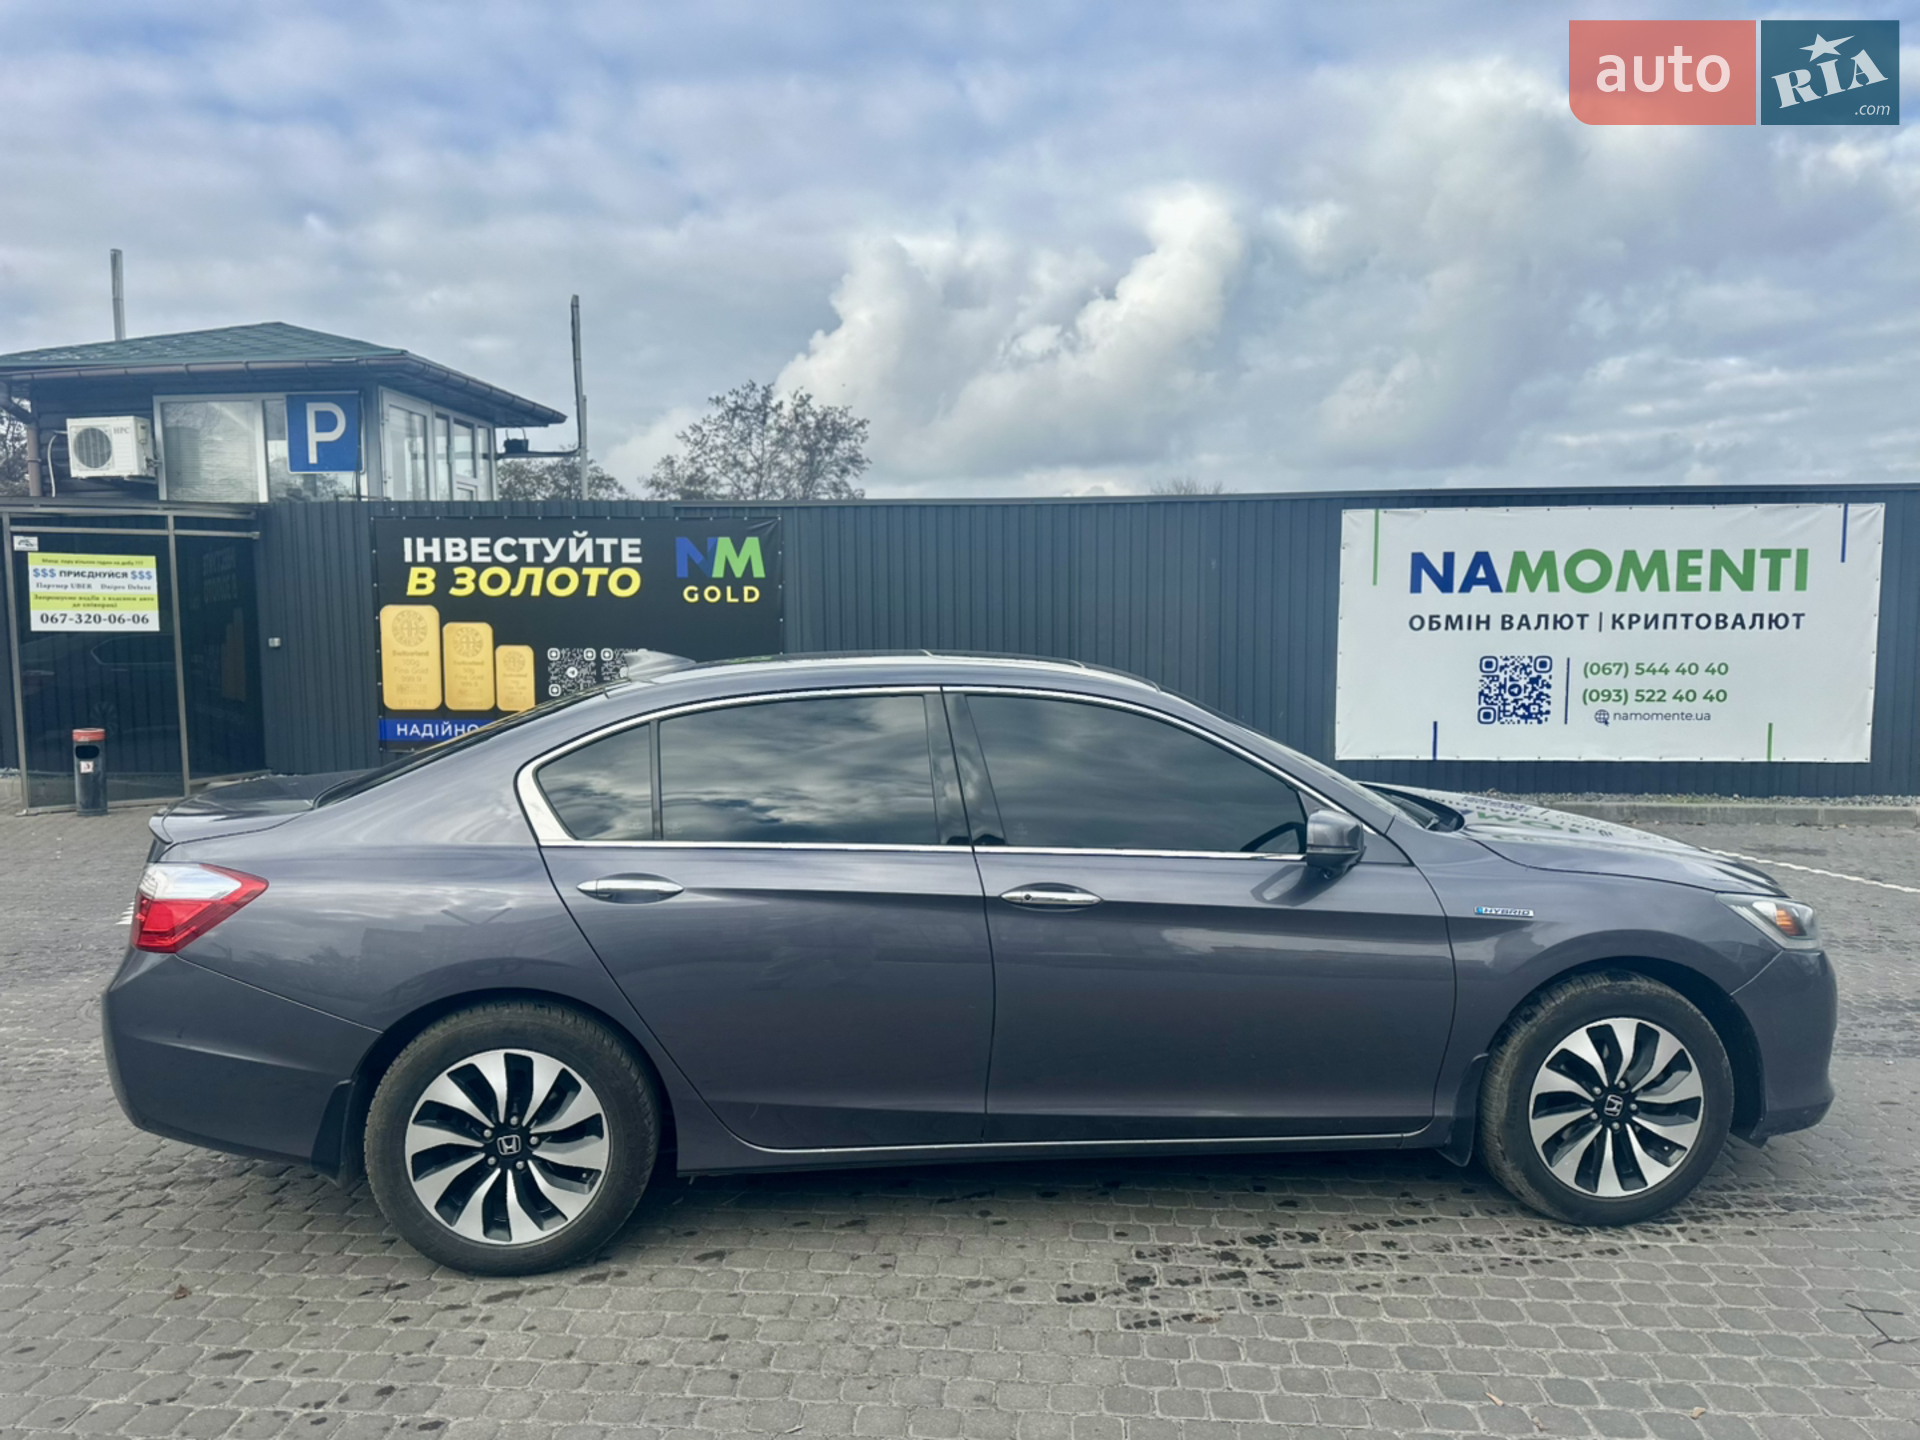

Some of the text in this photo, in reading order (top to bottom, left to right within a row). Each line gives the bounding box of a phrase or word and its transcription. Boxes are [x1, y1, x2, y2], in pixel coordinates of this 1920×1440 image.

[306, 402, 347, 465] P
[403, 530, 642, 564] ІНВЕСТУЙТЕ
[675, 536, 765, 579] NM
[33, 568, 57, 578] $$$
[130, 570, 153, 580] $$$
[1408, 548, 1810, 595] NAMOMENTI
[406, 567, 642, 597] В ЗОЛОТО
[683, 586, 760, 603] GOLD
[40, 613, 149, 624] 067-320-06-06
[1408, 612, 1806, 631] ОБМІН ВАЛЮТ КРИПТОВАЛЮТ
[1583, 661, 1729, 679] (067) 544 40 40
[1582, 688, 1728, 705] (093) 522 40 40
[1613, 711, 1711, 721] namomente.ua
